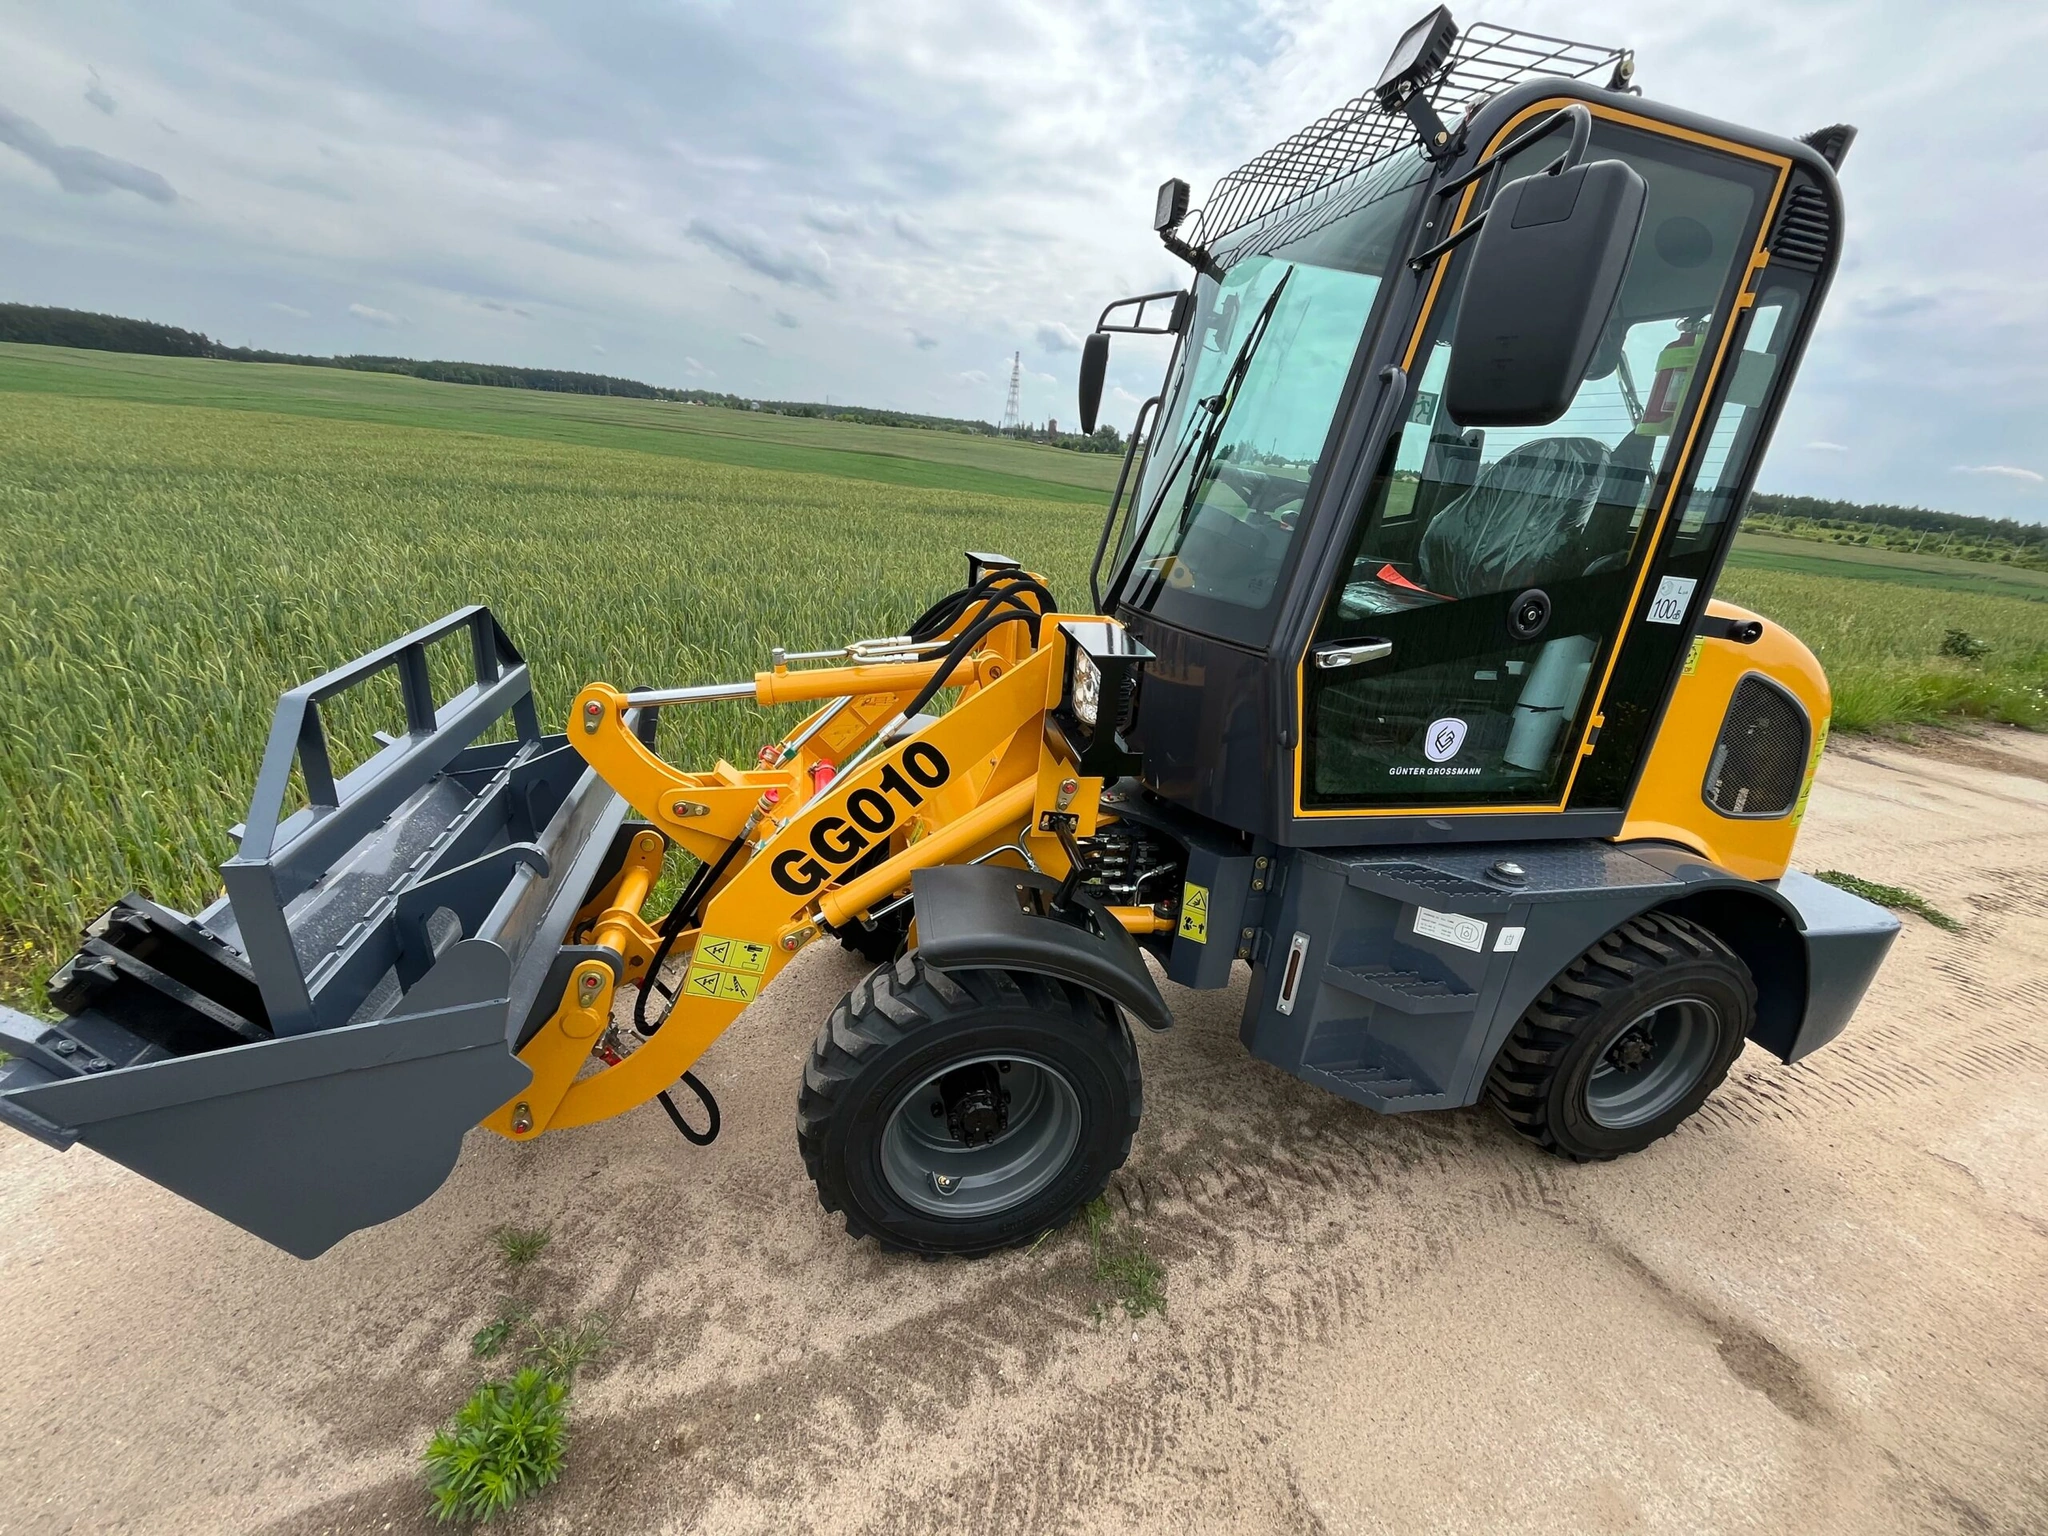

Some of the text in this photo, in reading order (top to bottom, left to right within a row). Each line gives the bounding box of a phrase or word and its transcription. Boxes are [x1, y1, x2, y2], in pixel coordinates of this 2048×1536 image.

[1389, 766, 1482, 776] GÜNTER GROSSMANN
[771, 741, 951, 896] GG010
